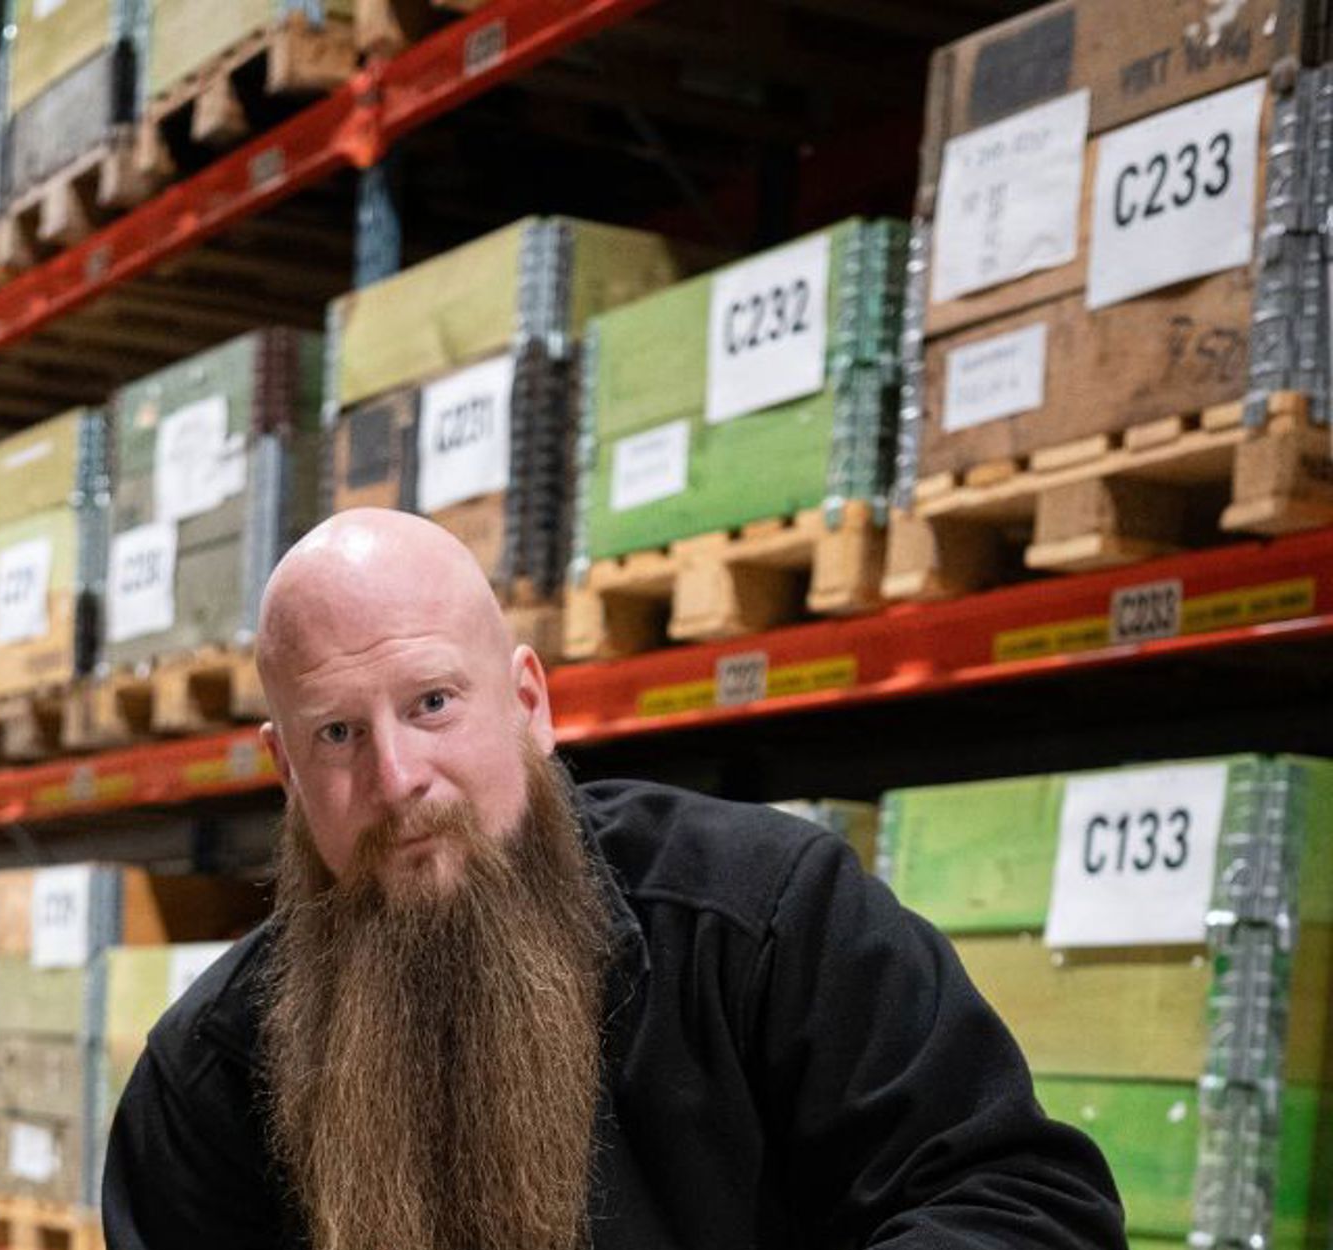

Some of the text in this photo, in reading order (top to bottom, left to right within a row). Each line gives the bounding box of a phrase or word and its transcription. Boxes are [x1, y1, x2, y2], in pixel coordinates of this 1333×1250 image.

[1114, 132, 1232, 228] C233
[723, 278, 811, 357] C232
[1084, 809, 1191, 874] C133
